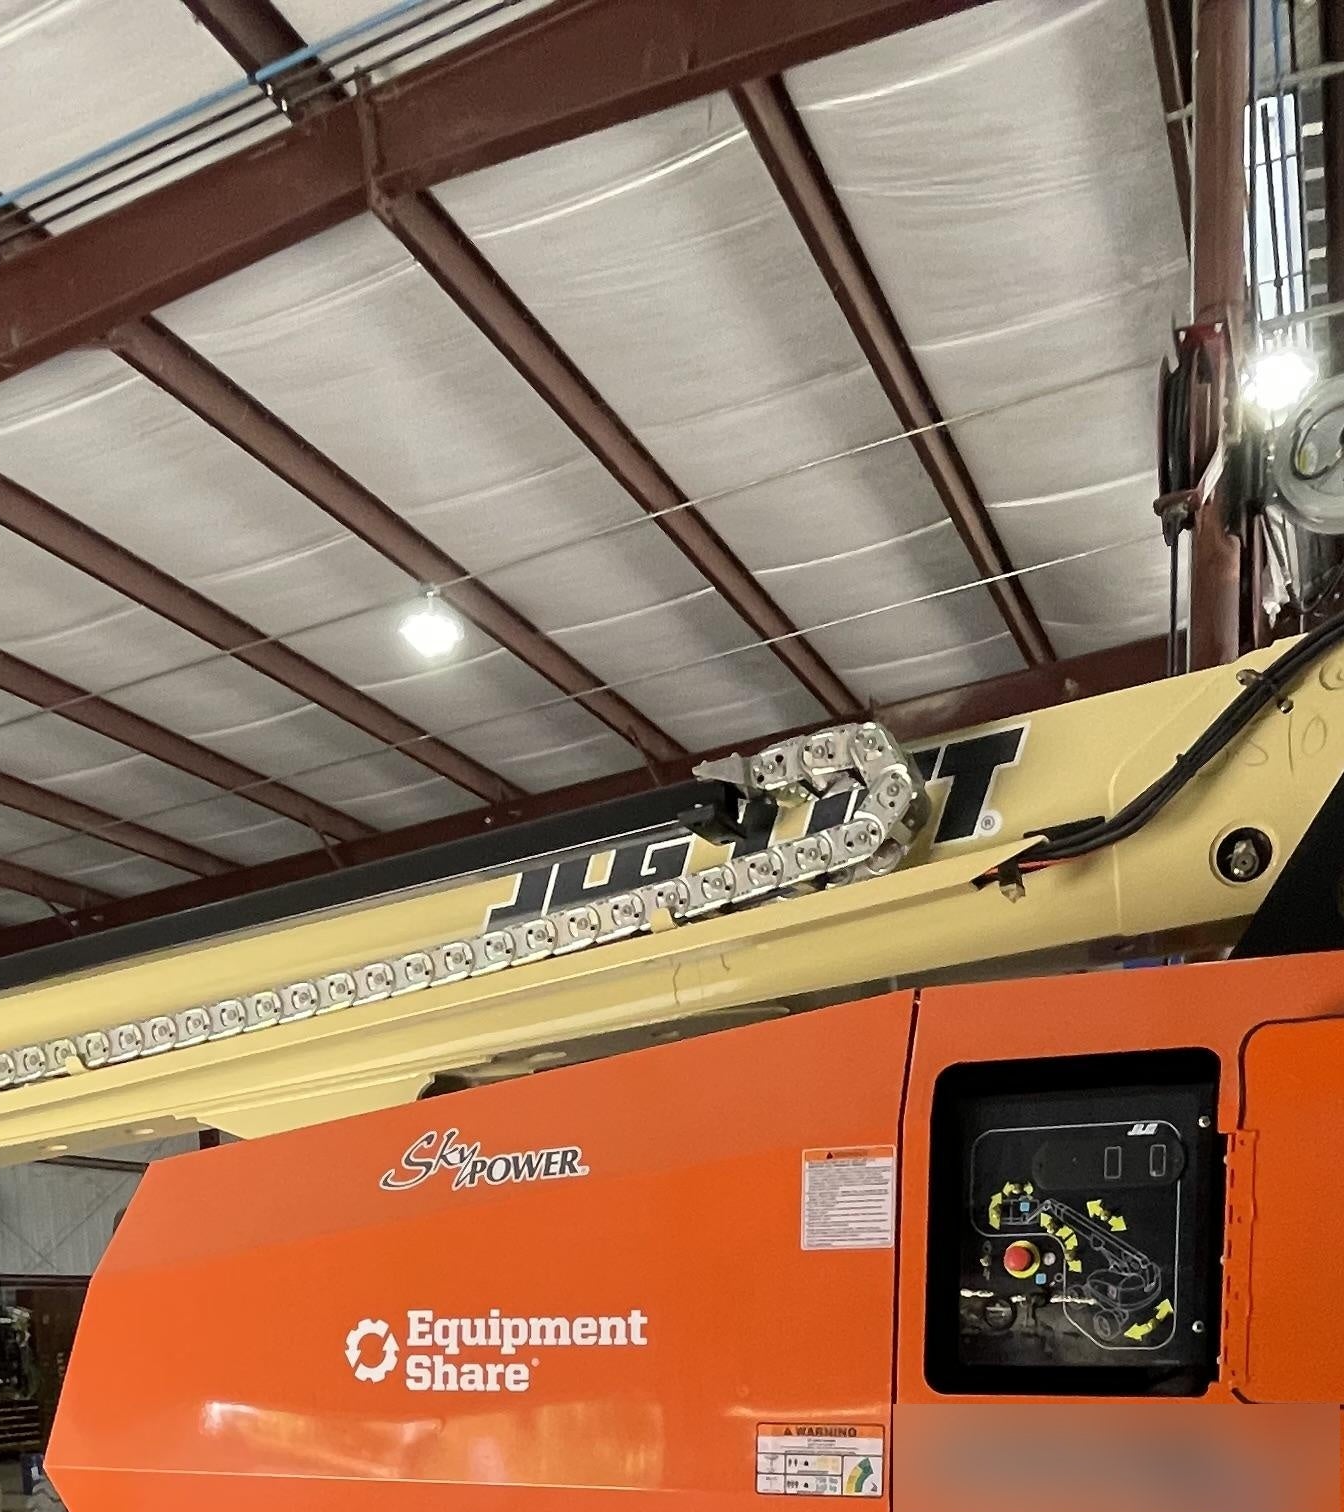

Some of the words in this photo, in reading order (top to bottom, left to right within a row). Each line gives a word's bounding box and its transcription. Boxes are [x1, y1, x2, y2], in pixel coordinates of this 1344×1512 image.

[407, 1308, 649, 1355] Equipment
[406, 1354, 530, 1393] Share
[795, 1426, 858, 1438] WARNING
